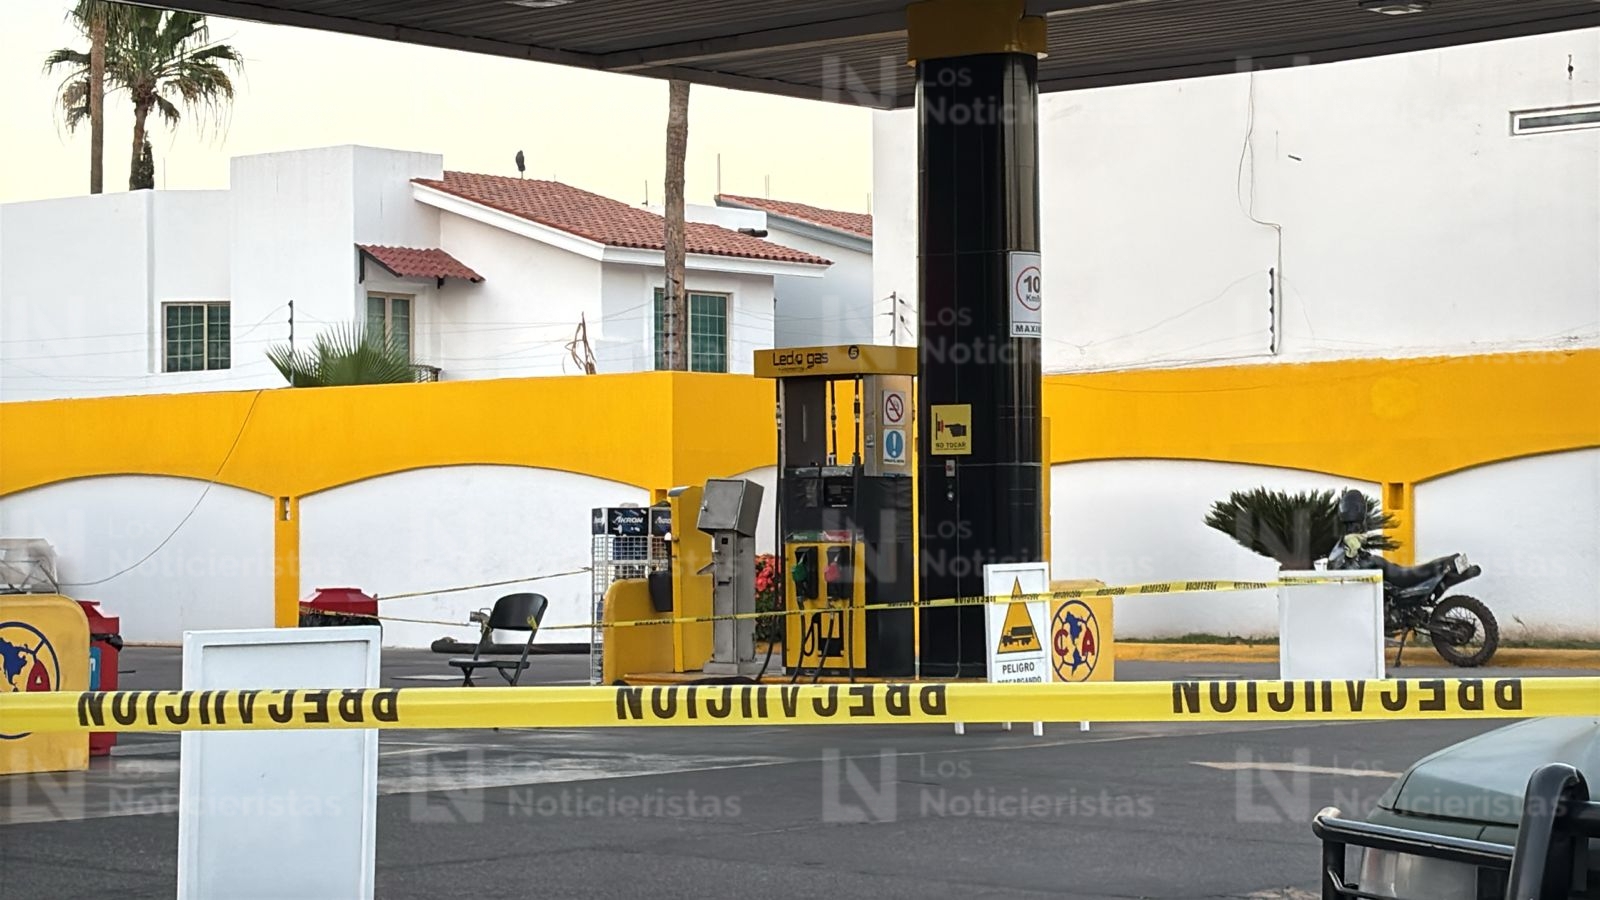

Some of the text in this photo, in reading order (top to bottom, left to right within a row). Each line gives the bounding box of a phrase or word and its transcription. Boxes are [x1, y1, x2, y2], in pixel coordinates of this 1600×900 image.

[1024, 275, 1041, 293] 10
[807, 353, 829, 369] gas
[946, 441, 966, 449] TOCAR
[613, 515, 644, 524] AKRON
[1002, 662, 1035, 674] PELIGRO
